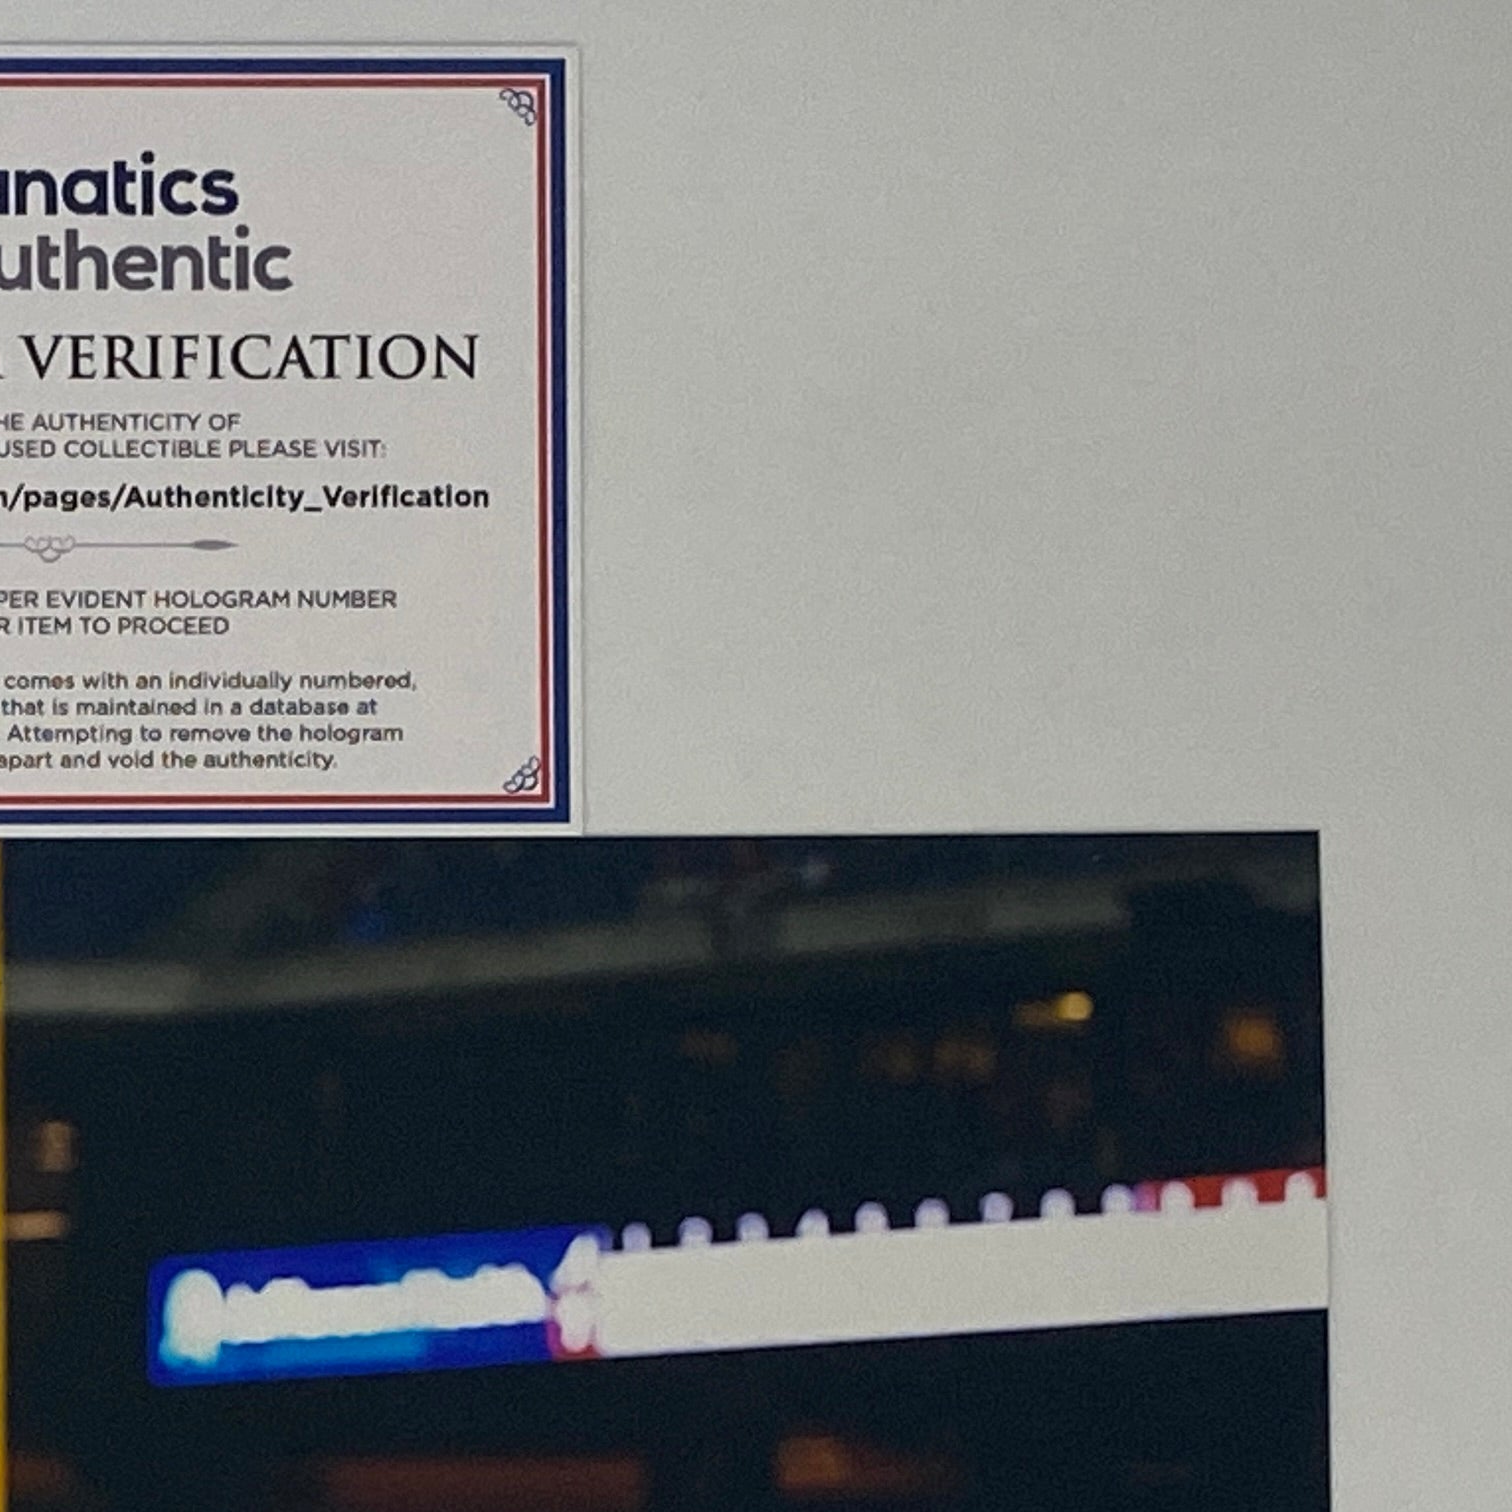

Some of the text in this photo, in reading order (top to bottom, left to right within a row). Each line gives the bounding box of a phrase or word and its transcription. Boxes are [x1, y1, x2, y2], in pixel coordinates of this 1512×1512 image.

[18, 333, 479, 380] VERIFICATION
[31, 412, 202, 432] AUTHENTICITY
[208, 412, 241, 432] OF
[63, 439, 222, 459] COLLECTIBLE
[228, 439, 318, 459] PLEASE
[323, 439, 385, 459] VISIT:
[46, 589, 147, 609] EVIDENT
[153, 589, 291, 609] HOLOGRAM
[297, 589, 398, 609] NUMBER
[18, 615, 72, 635] ITEM
[78, 615, 111, 635] TO
[117, 615, 230, 636] PROCEED
[3, 675, 75, 690] comes
[82, 671, 129, 690] with
[135, 675, 162, 690] an
[169, 670, 293, 694] individually
[299, 670, 417, 692] numbered,
[0, 698, 45, 716] that
[52, 698, 69, 716] is
[76, 697, 197, 716] maintained
[204, 698, 223, 716] in
[230, 701, 242, 716] a
[249, 697, 350, 716] database
[356, 698, 378, 716] at
[7, 724, 133, 746] Attempting
[140, 725, 162, 742] to
[169, 727, 251, 742] remove
[257, 725, 293, 742] the
[299, 724, 404, 746] hologram
[60, 750, 101, 769] and
[107, 749, 154, 769] void
[161, 750, 198, 769] the
[203, 750, 335, 772] authenticity.
